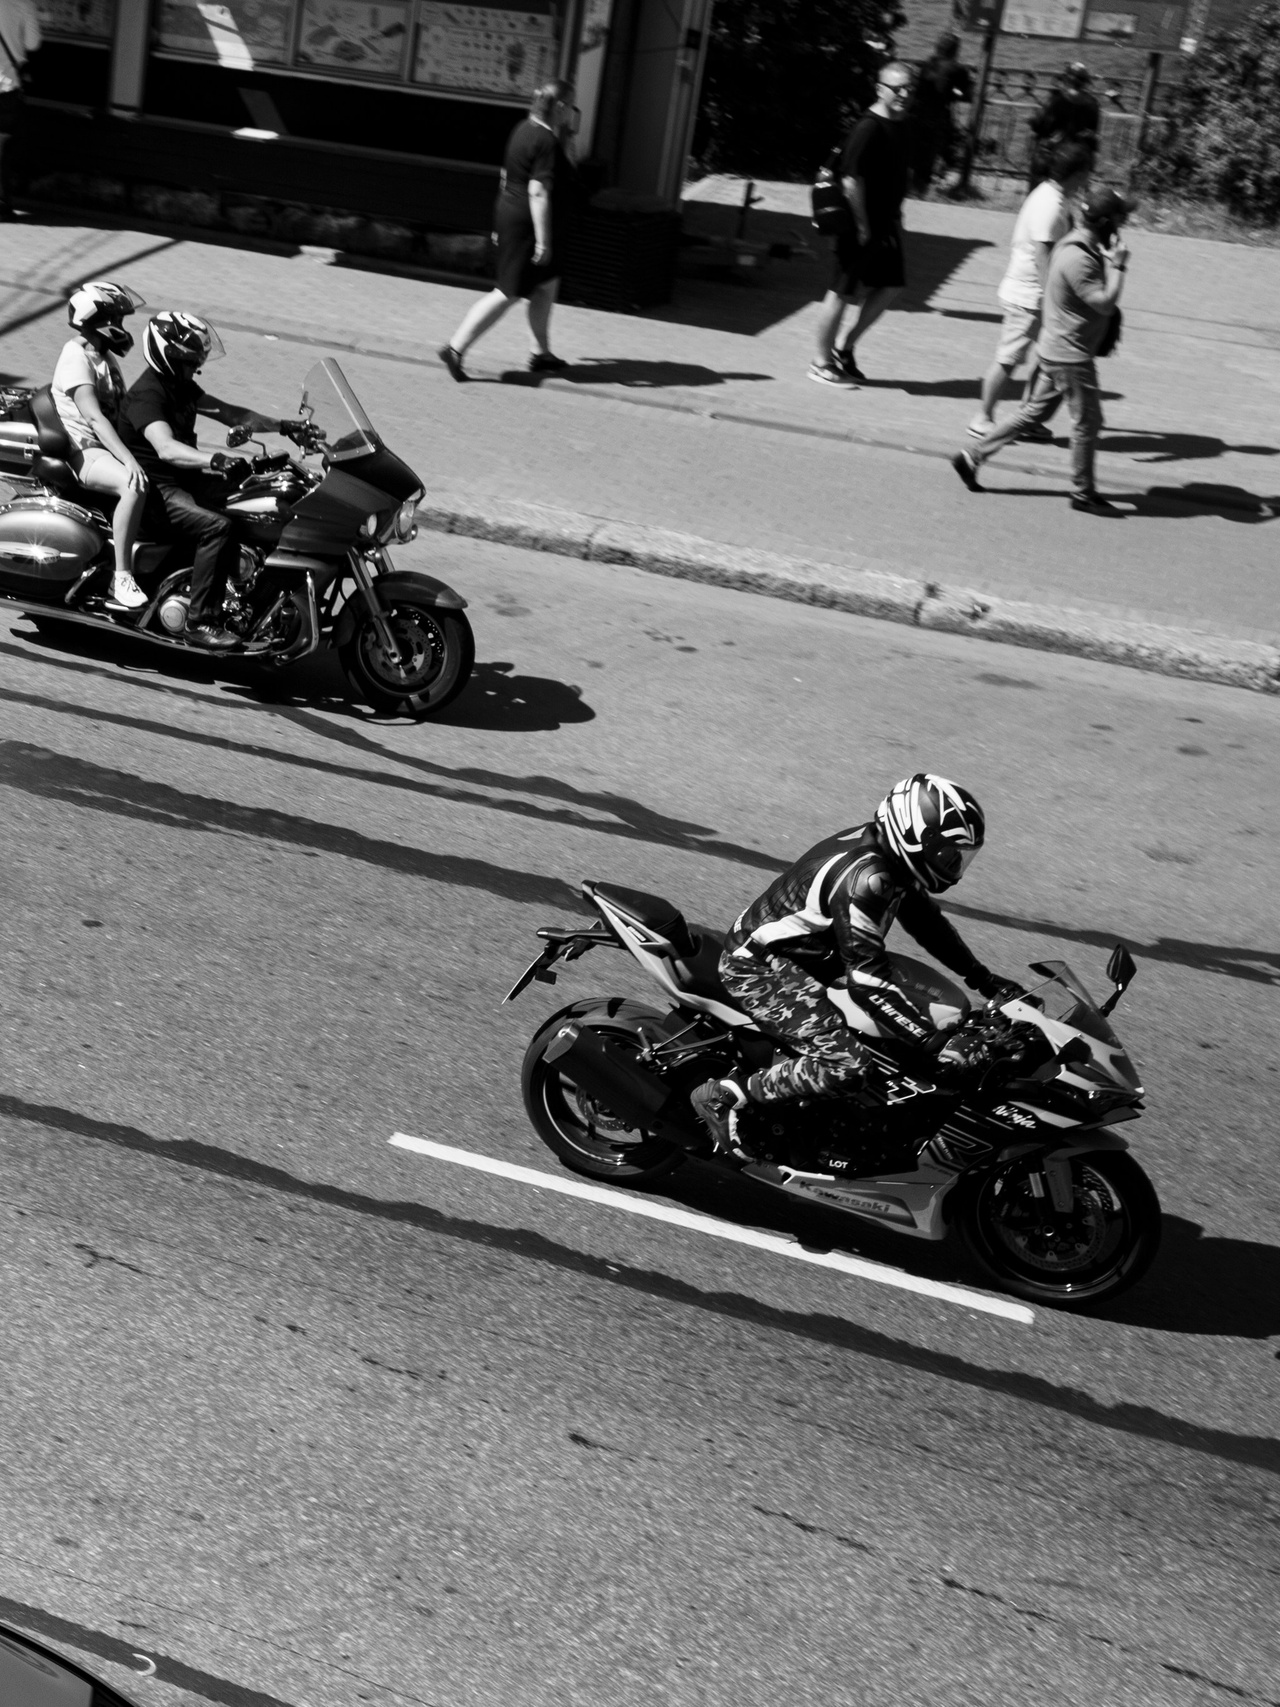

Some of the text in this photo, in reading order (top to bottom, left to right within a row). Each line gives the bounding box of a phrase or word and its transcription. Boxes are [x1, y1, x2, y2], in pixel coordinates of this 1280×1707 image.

[868, 994, 928, 1038] DAINESE
[991, 1105, 1037, 1129] Ninja
[829, 1159, 849, 1169] LOT
[800, 1181, 891, 1213] Kawasaki
